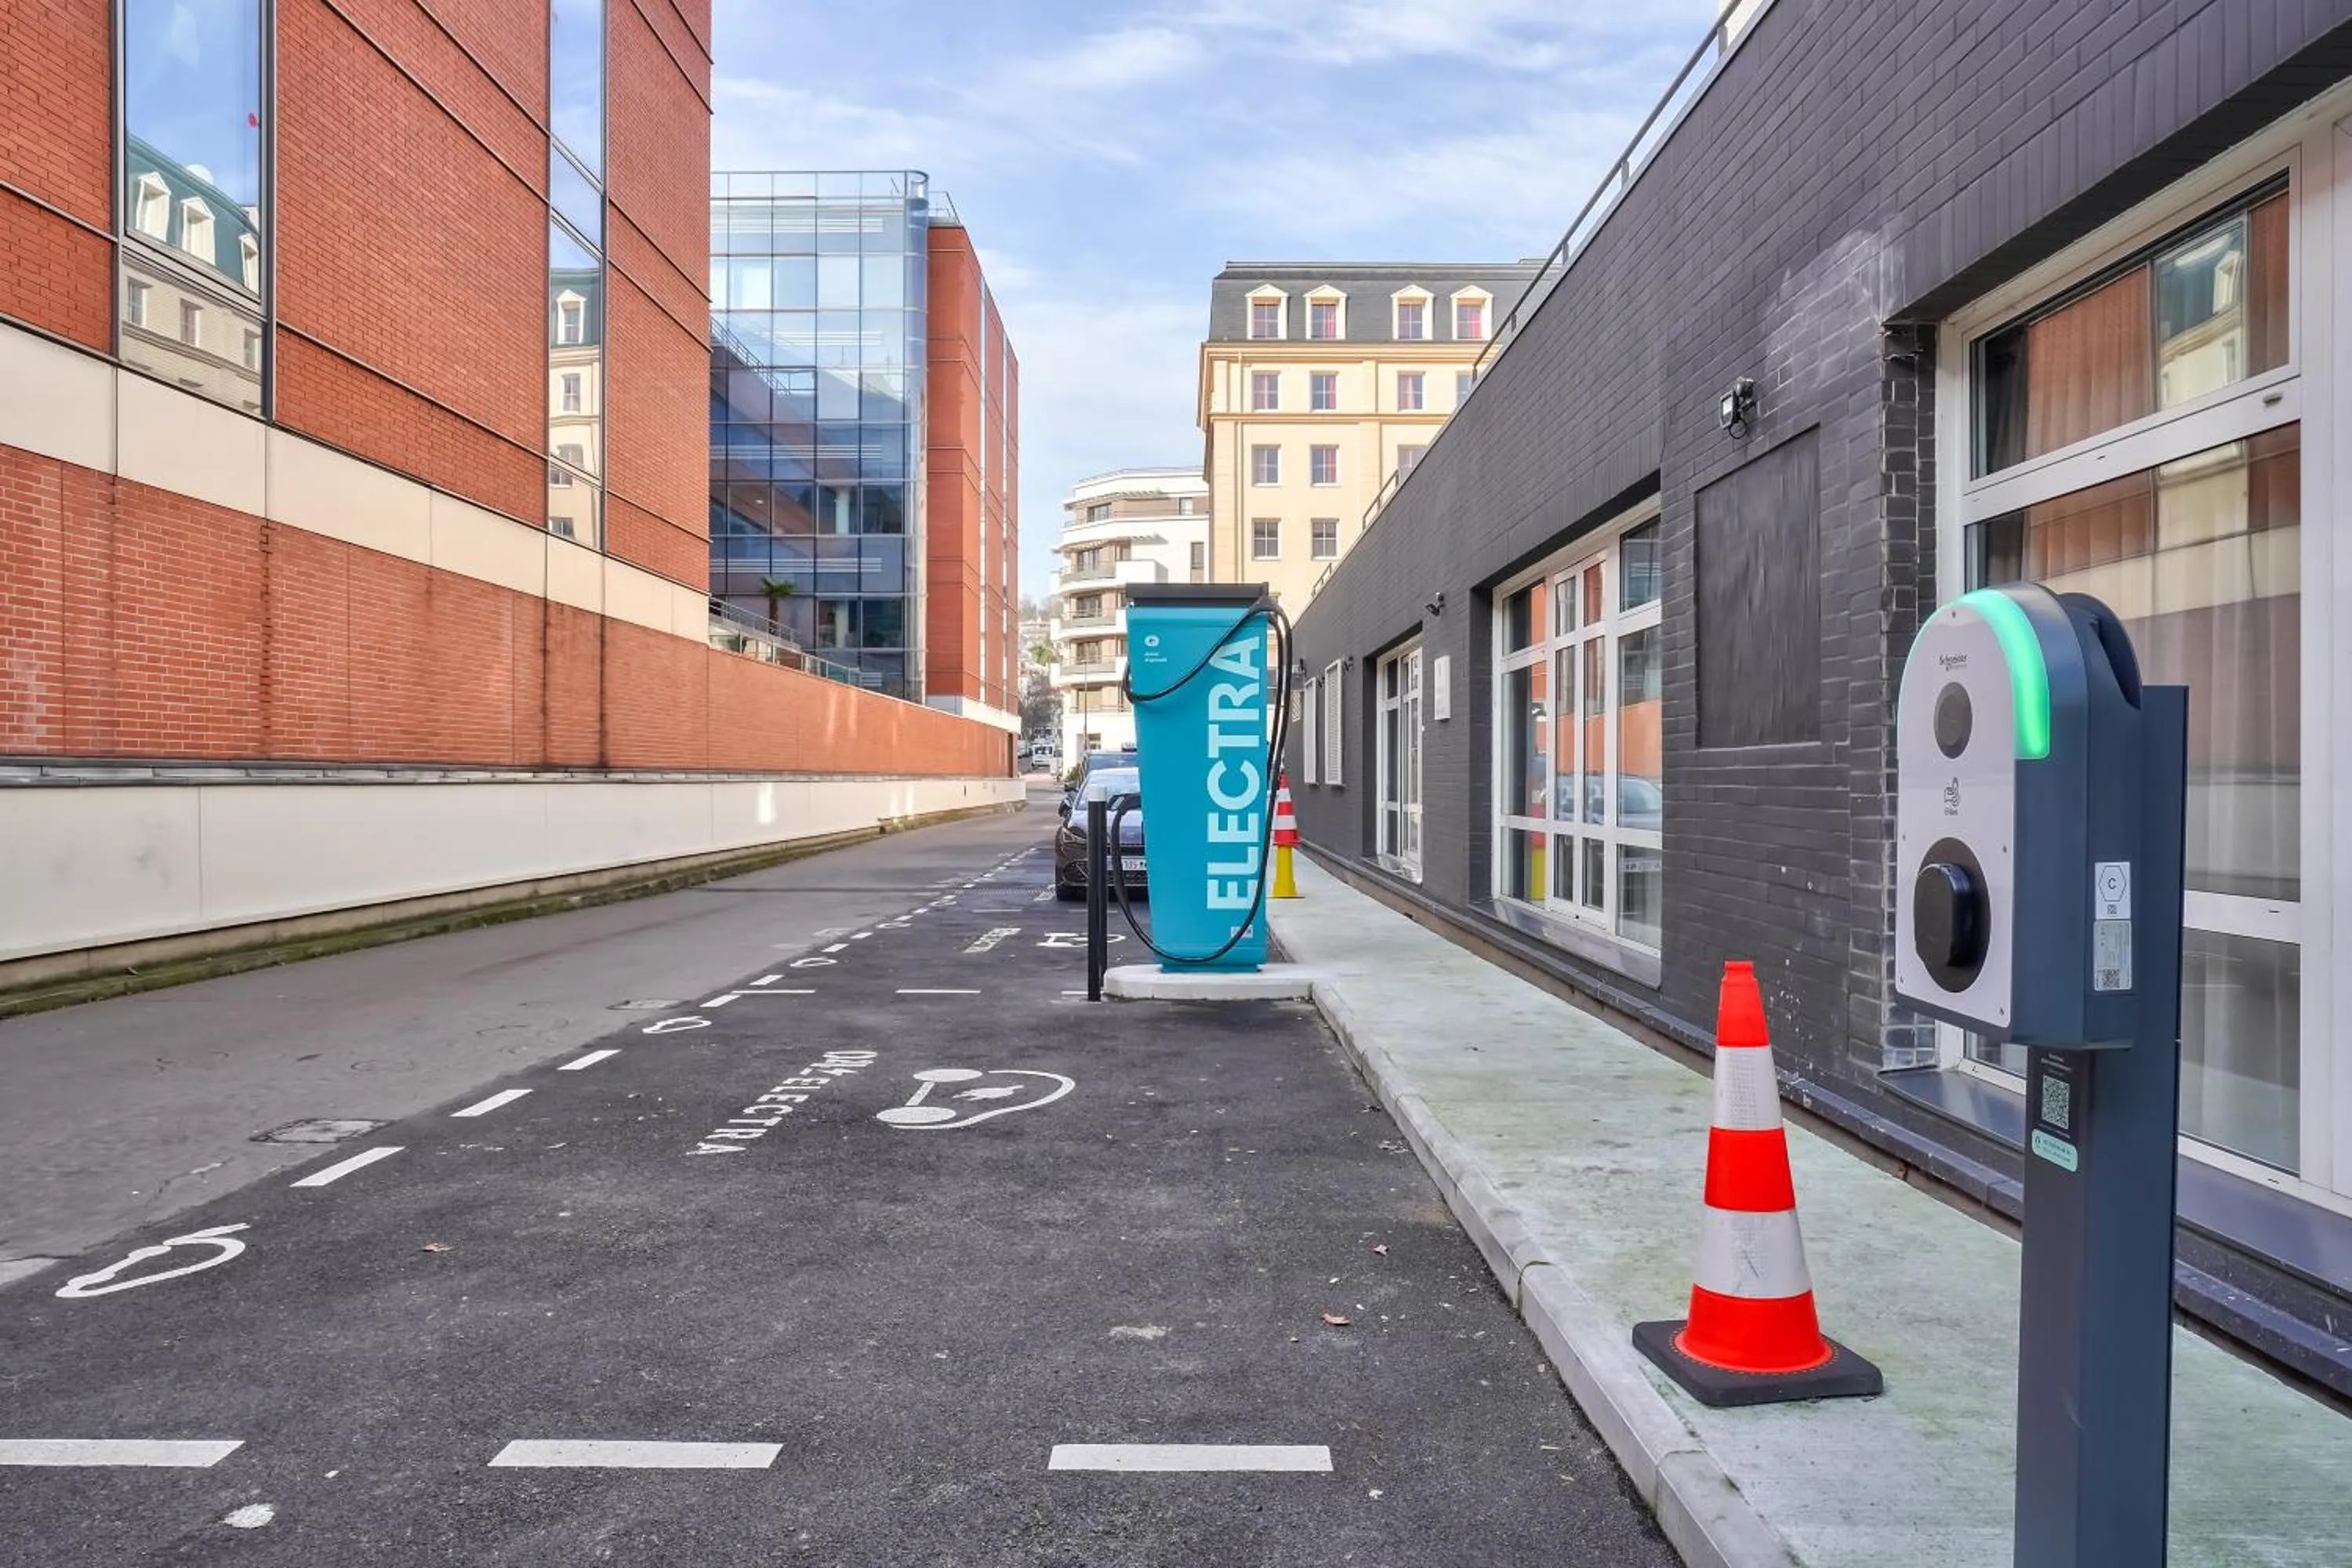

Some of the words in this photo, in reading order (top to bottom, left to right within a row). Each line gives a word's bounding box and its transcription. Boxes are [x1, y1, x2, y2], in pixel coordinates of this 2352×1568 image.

[1207, 636, 1260, 910] ELECTRA
[2107, 877, 2117, 890] C
[686, 1077, 831, 1156] ELECTRA
